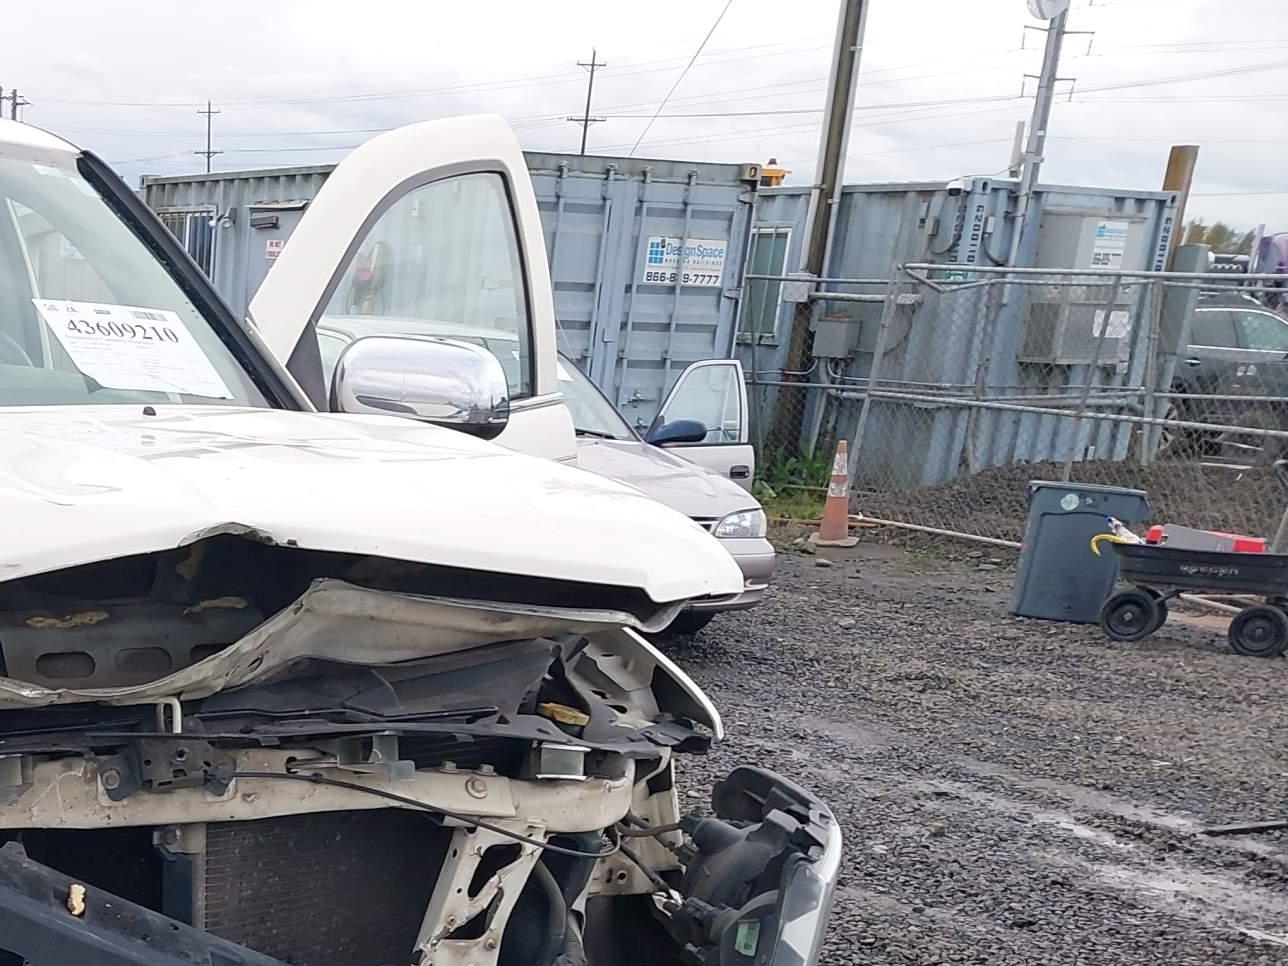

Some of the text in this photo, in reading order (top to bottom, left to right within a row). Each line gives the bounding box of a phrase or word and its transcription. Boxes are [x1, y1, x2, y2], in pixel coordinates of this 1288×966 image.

[665, 243, 724, 259] DesgnSpace
[645, 271, 720, 285] 866-89-7777
[67, 319, 179, 344] 43609210
